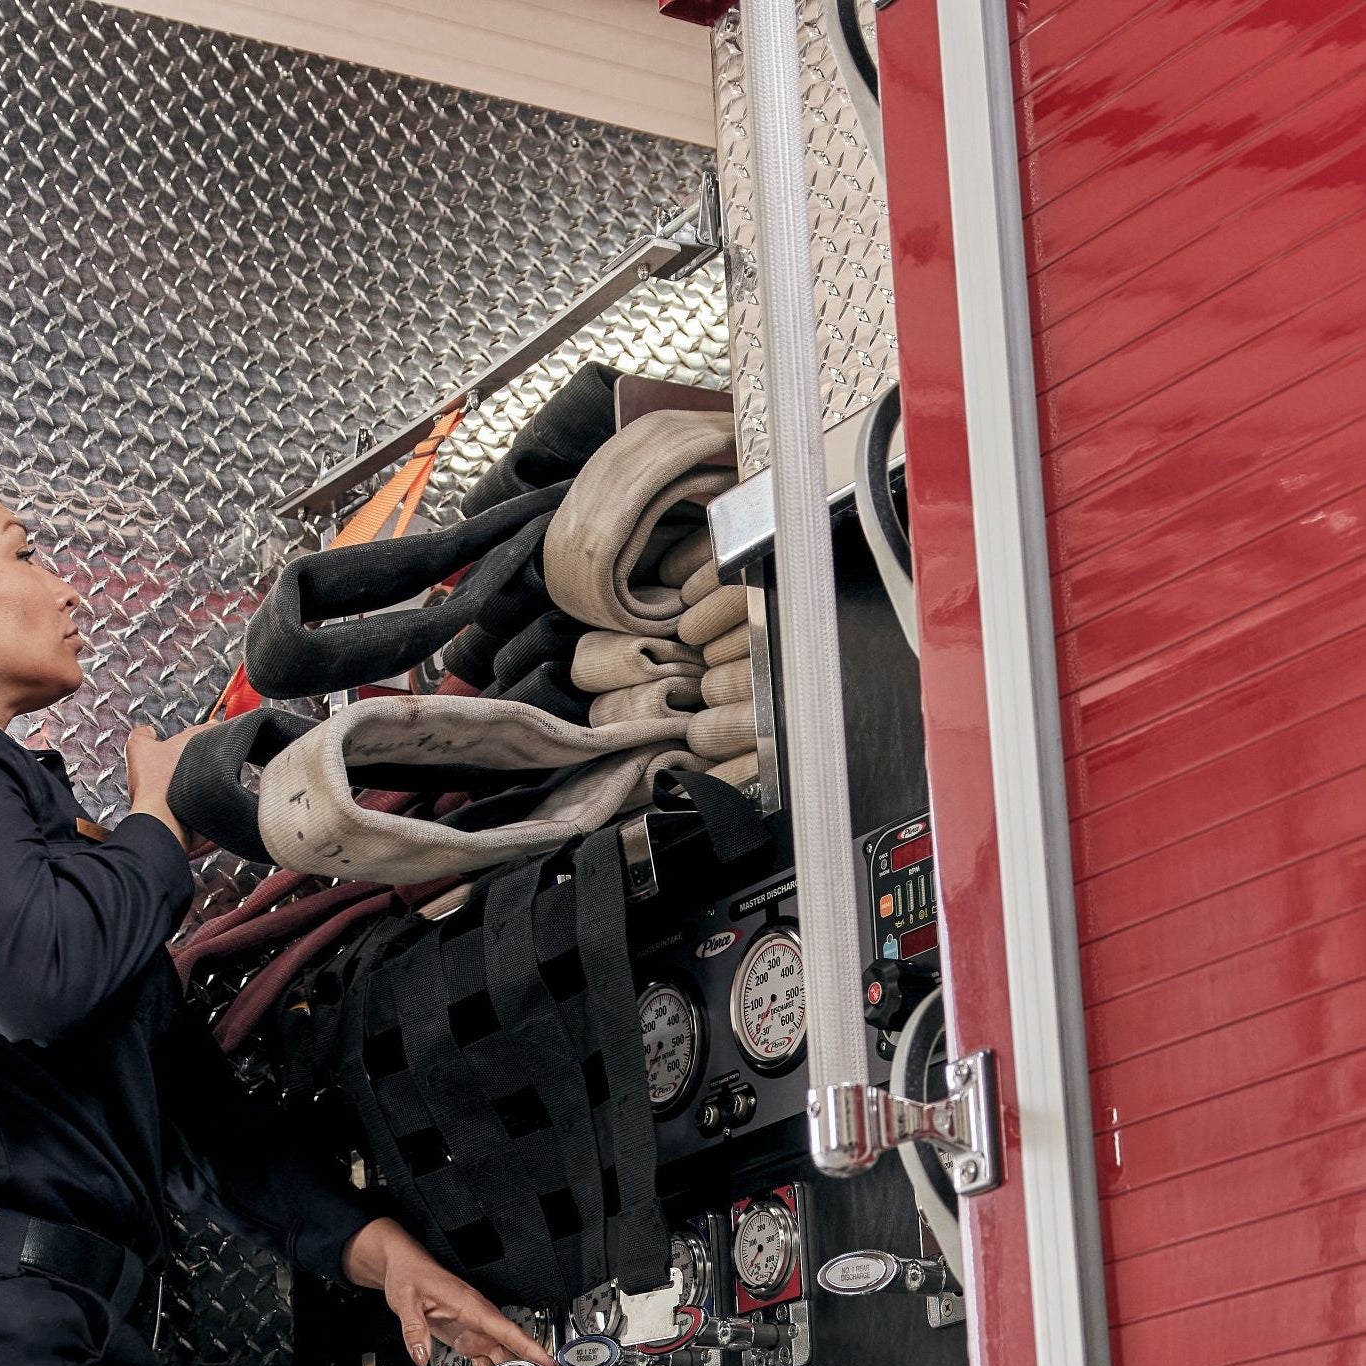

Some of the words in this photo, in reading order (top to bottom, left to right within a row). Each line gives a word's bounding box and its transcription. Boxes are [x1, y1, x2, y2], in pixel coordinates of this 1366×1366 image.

[908, 865, 921, 876] RPM
[739, 894, 766, 912] MASTER
[766, 880, 800, 900] DISCHARG
[702, 933, 732, 958] Pierce
[767, 956, 781, 971] 300
[780, 964, 794, 978] 400
[755, 972, 769, 986] 200
[785, 986, 799, 1000] 500
[750, 996, 763, 1011] 100
[654, 1005, 667, 1019] 300
[780, 1012, 794, 1026] 600
[643, 1020, 656, 1034] 200
[667, 1013, 680, 1027] 400
[671, 1034, 684, 1048] 500
[667, 1059, 680, 1072] 600
[841, 1272, 870, 1282] DISCHARGE
